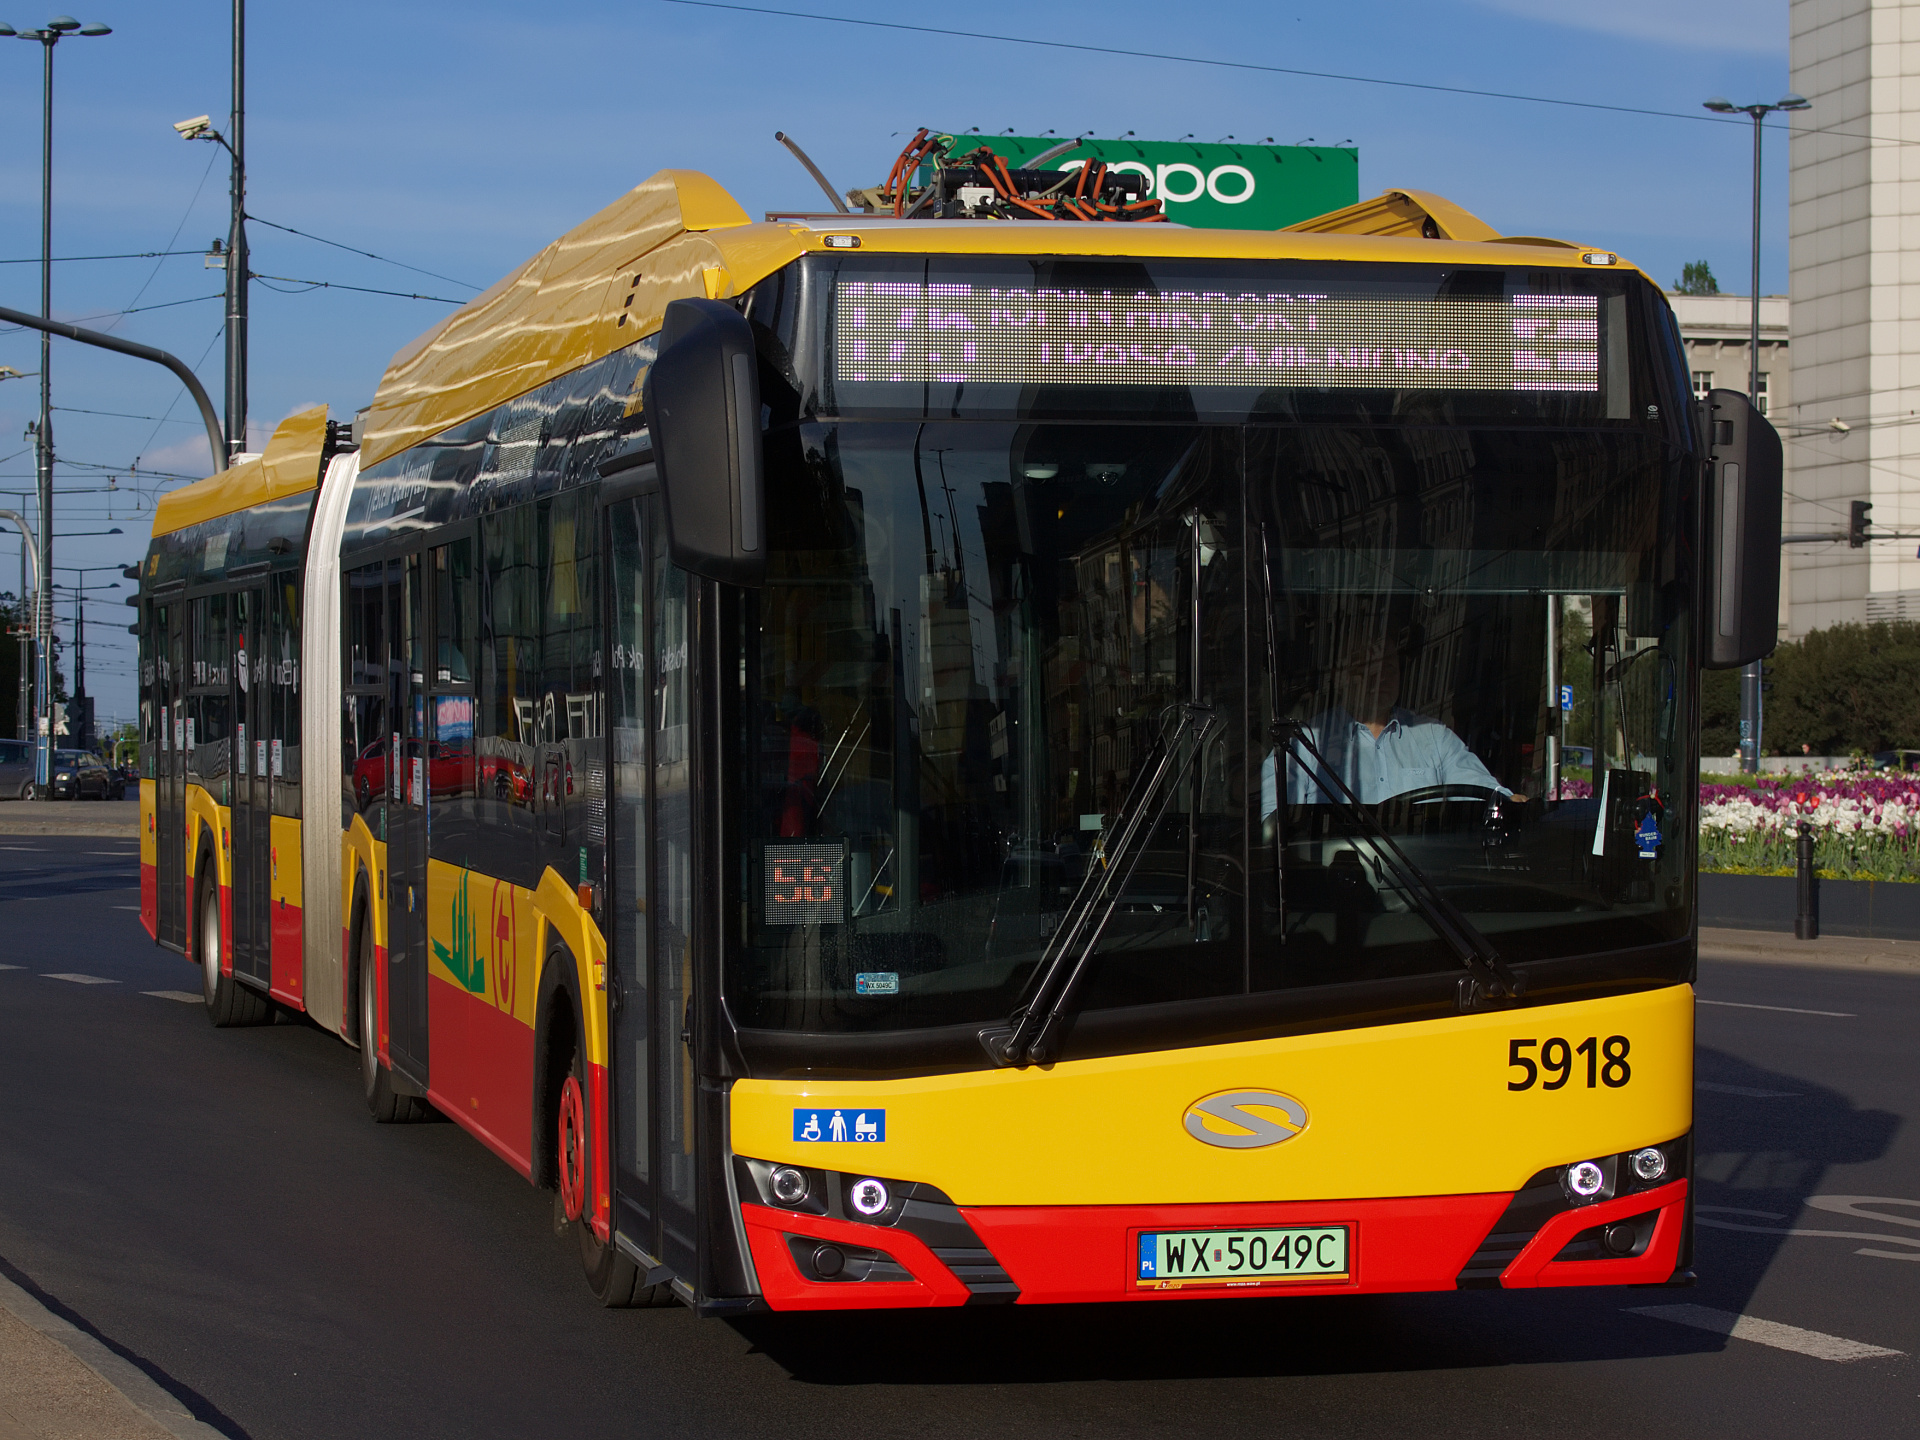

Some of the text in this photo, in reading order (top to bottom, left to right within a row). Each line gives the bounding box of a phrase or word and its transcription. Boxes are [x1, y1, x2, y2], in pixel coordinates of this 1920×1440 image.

[773, 858, 832, 903] 56
[1507, 1034, 1632, 1092] 5918
[1141, 1260, 1155, 1271] PL
[1165, 1233, 1337, 1273] WX 5049C
